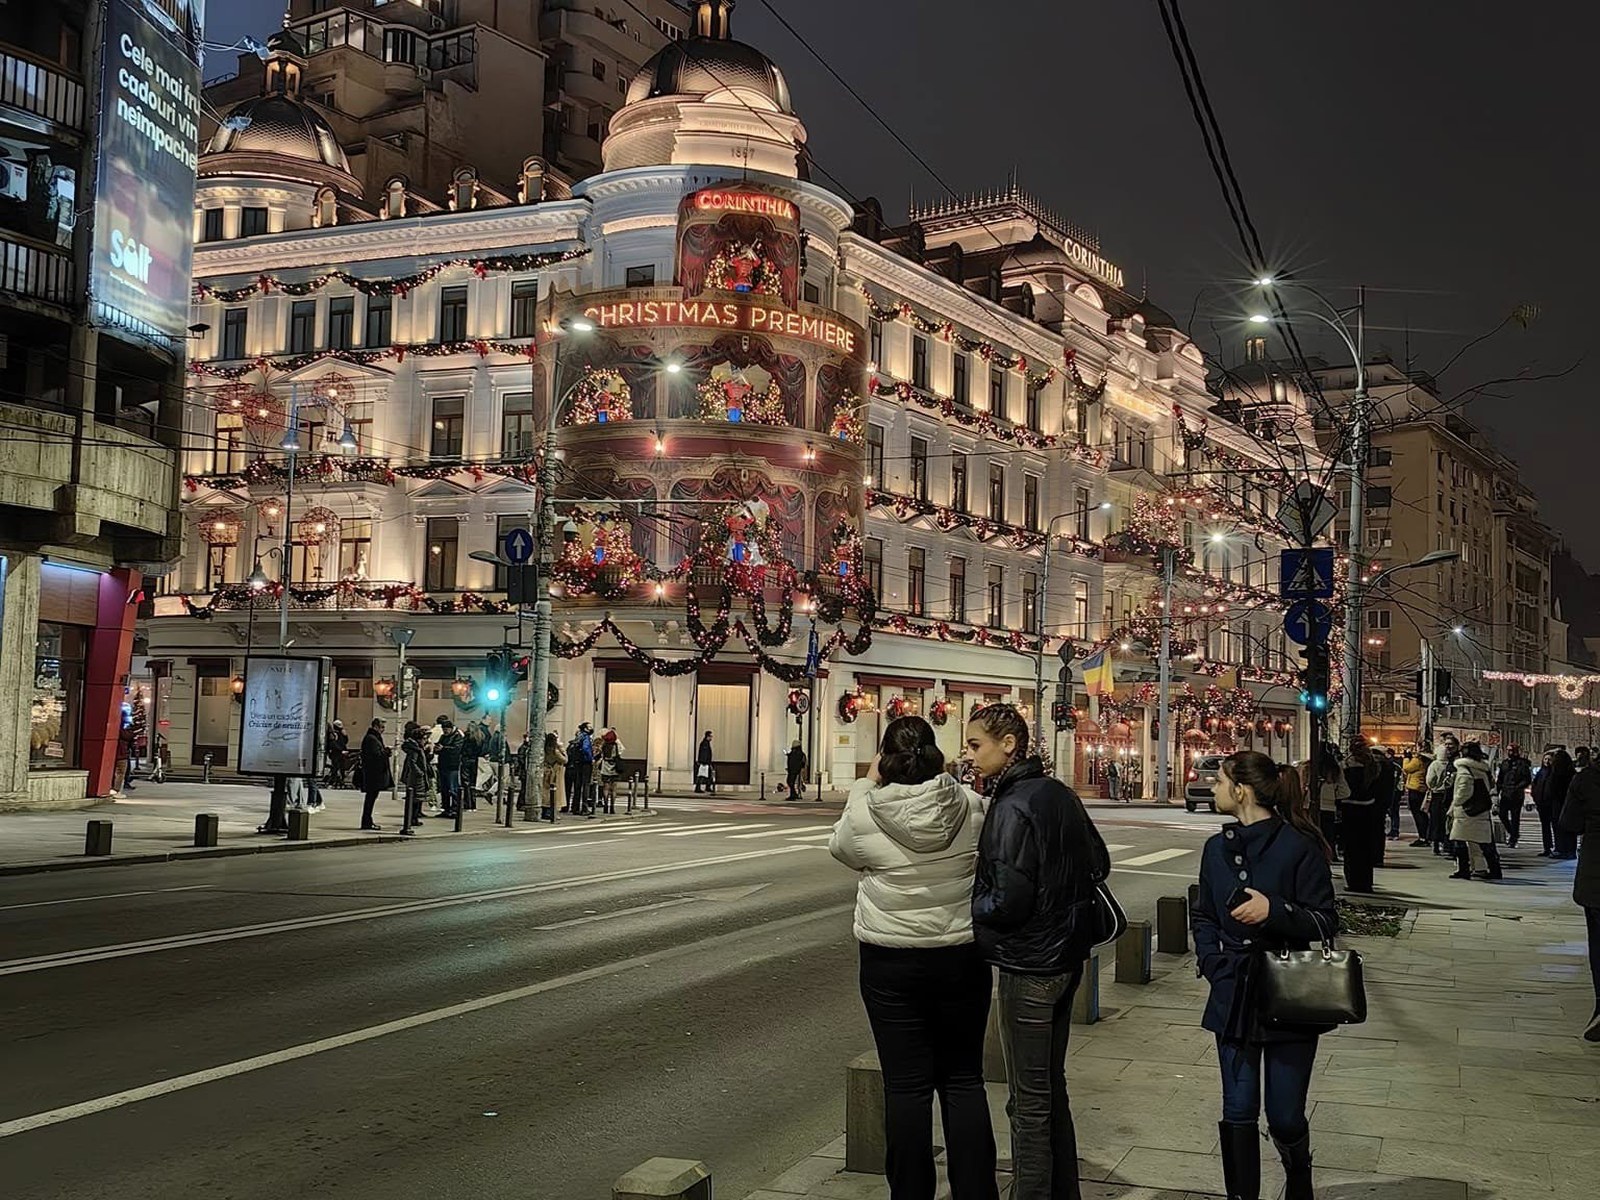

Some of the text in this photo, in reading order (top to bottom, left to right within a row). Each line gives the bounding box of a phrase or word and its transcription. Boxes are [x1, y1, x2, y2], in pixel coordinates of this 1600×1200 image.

[120, 33, 154, 76] Cele
[155, 65, 183, 101] mai
[119, 68, 198, 143] cadouri vin
[700, 194, 793, 219] CORINTHIA
[1064, 238, 1124, 287] CORINTHIA
[751, 307, 855, 353] PREMIERE
